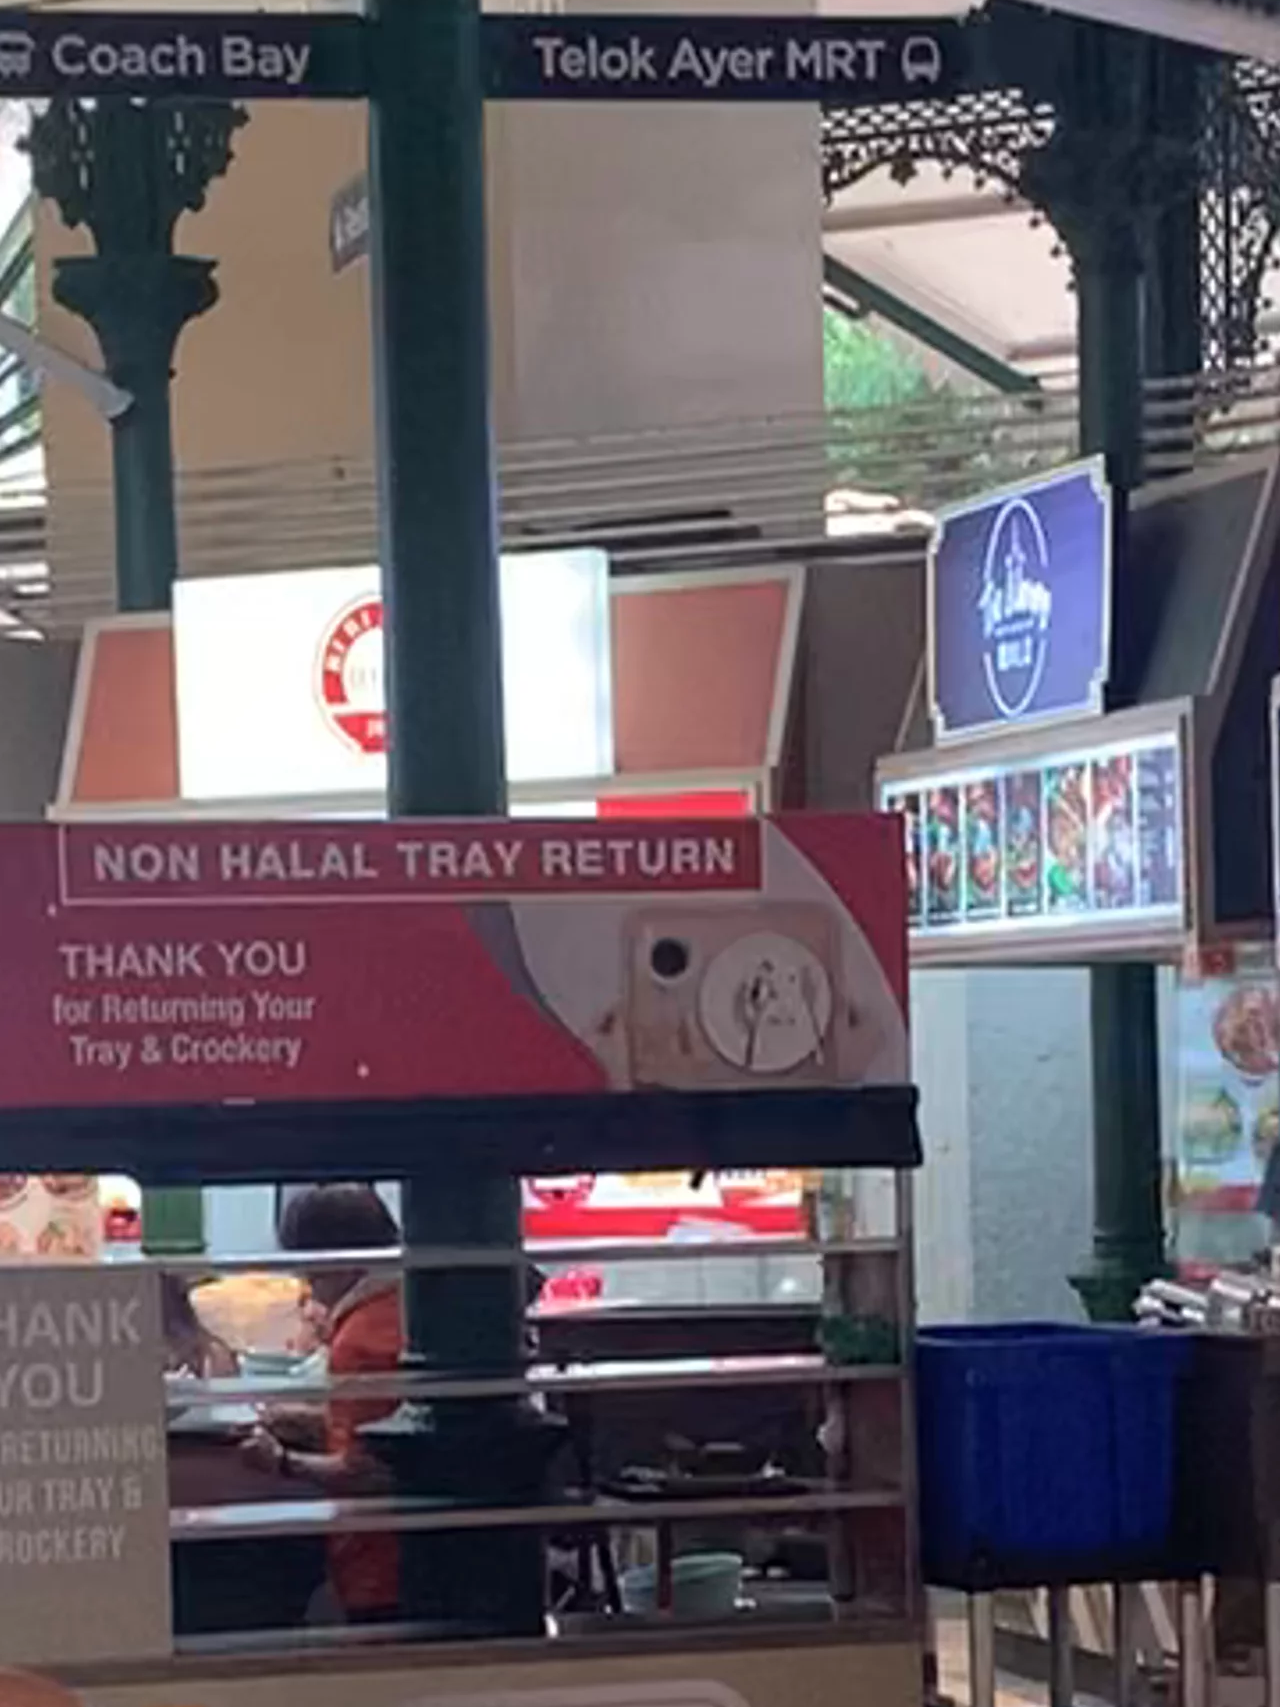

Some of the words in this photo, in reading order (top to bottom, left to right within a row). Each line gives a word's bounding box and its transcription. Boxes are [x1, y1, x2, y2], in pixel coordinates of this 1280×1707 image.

[51, 35, 205, 75] Coach
[221, 36, 310, 84] Bay
[533, 37, 657, 79] Telok
[667, 40, 773, 87] Ayer
[785, 40, 885, 80] MRT
[92, 843, 200, 881] NON
[221, 841, 379, 880] HALAL
[397, 840, 525, 878] TRAY
[541, 837, 735, 876] RETURN
[59, 943, 208, 979] THANK
[217, 941, 308, 977] YOU
[53, 995, 93, 1025] for
[100, 993, 244, 1029] Returning
[250, 992, 316, 1023] Your
[69, 1035, 133, 1069] Tray
[140, 1035, 163, 1064] &
[171, 1032, 302, 1068] Crockery
[0, 1423, 161, 1466] RETURNING
[40, 1475, 115, 1513] TRAY
[122, 1474, 143, 1511] &
